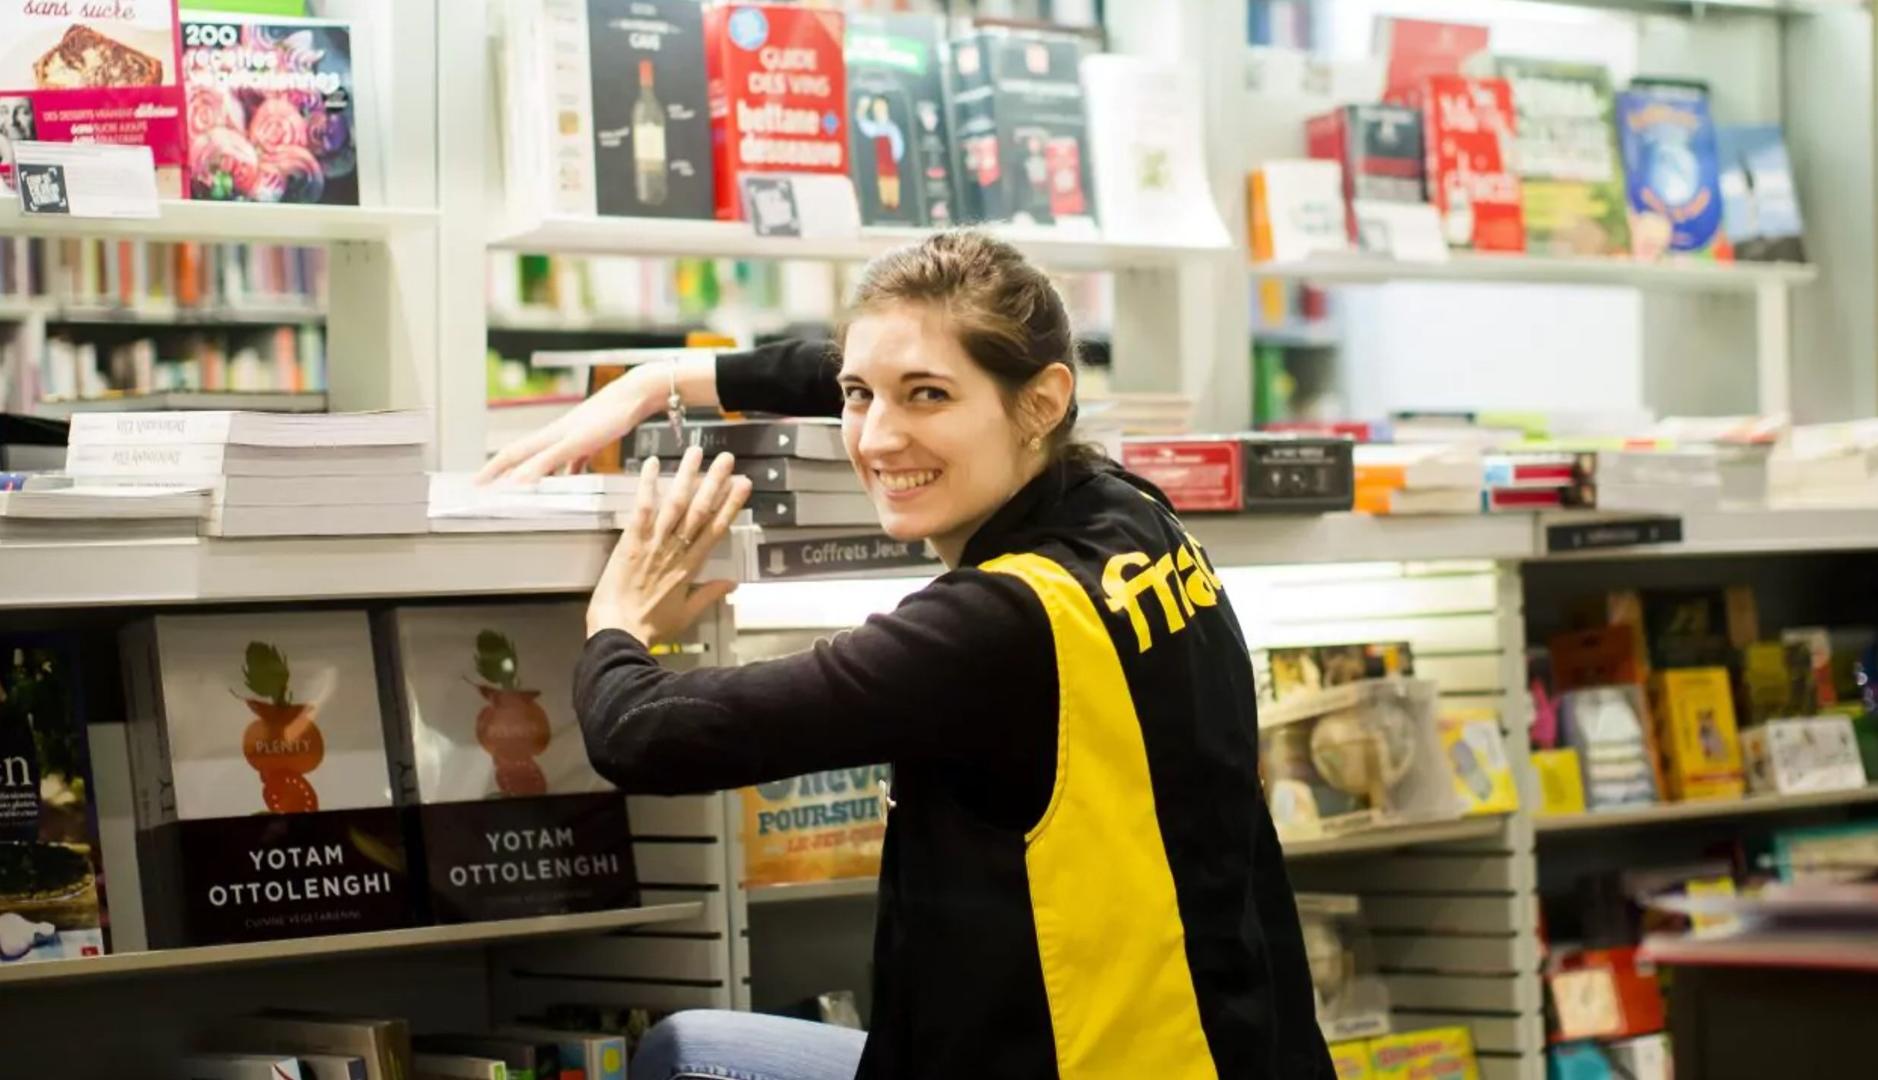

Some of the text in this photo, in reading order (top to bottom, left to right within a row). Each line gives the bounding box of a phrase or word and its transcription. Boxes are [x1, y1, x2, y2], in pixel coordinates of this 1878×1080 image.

[24, 0, 136, 20] sans sucre
[186, 24, 238, 46] 200
[801, 542, 869, 564] Coffrets
[255, 738, 311, 754] PLENTY
[486, 827, 575, 853] YOTAM
[249, 844, 343, 872] YOTAM
[449, 854, 619, 887] OTTOLENGHI
[208, 872, 391, 906] OTTOLENGHI
